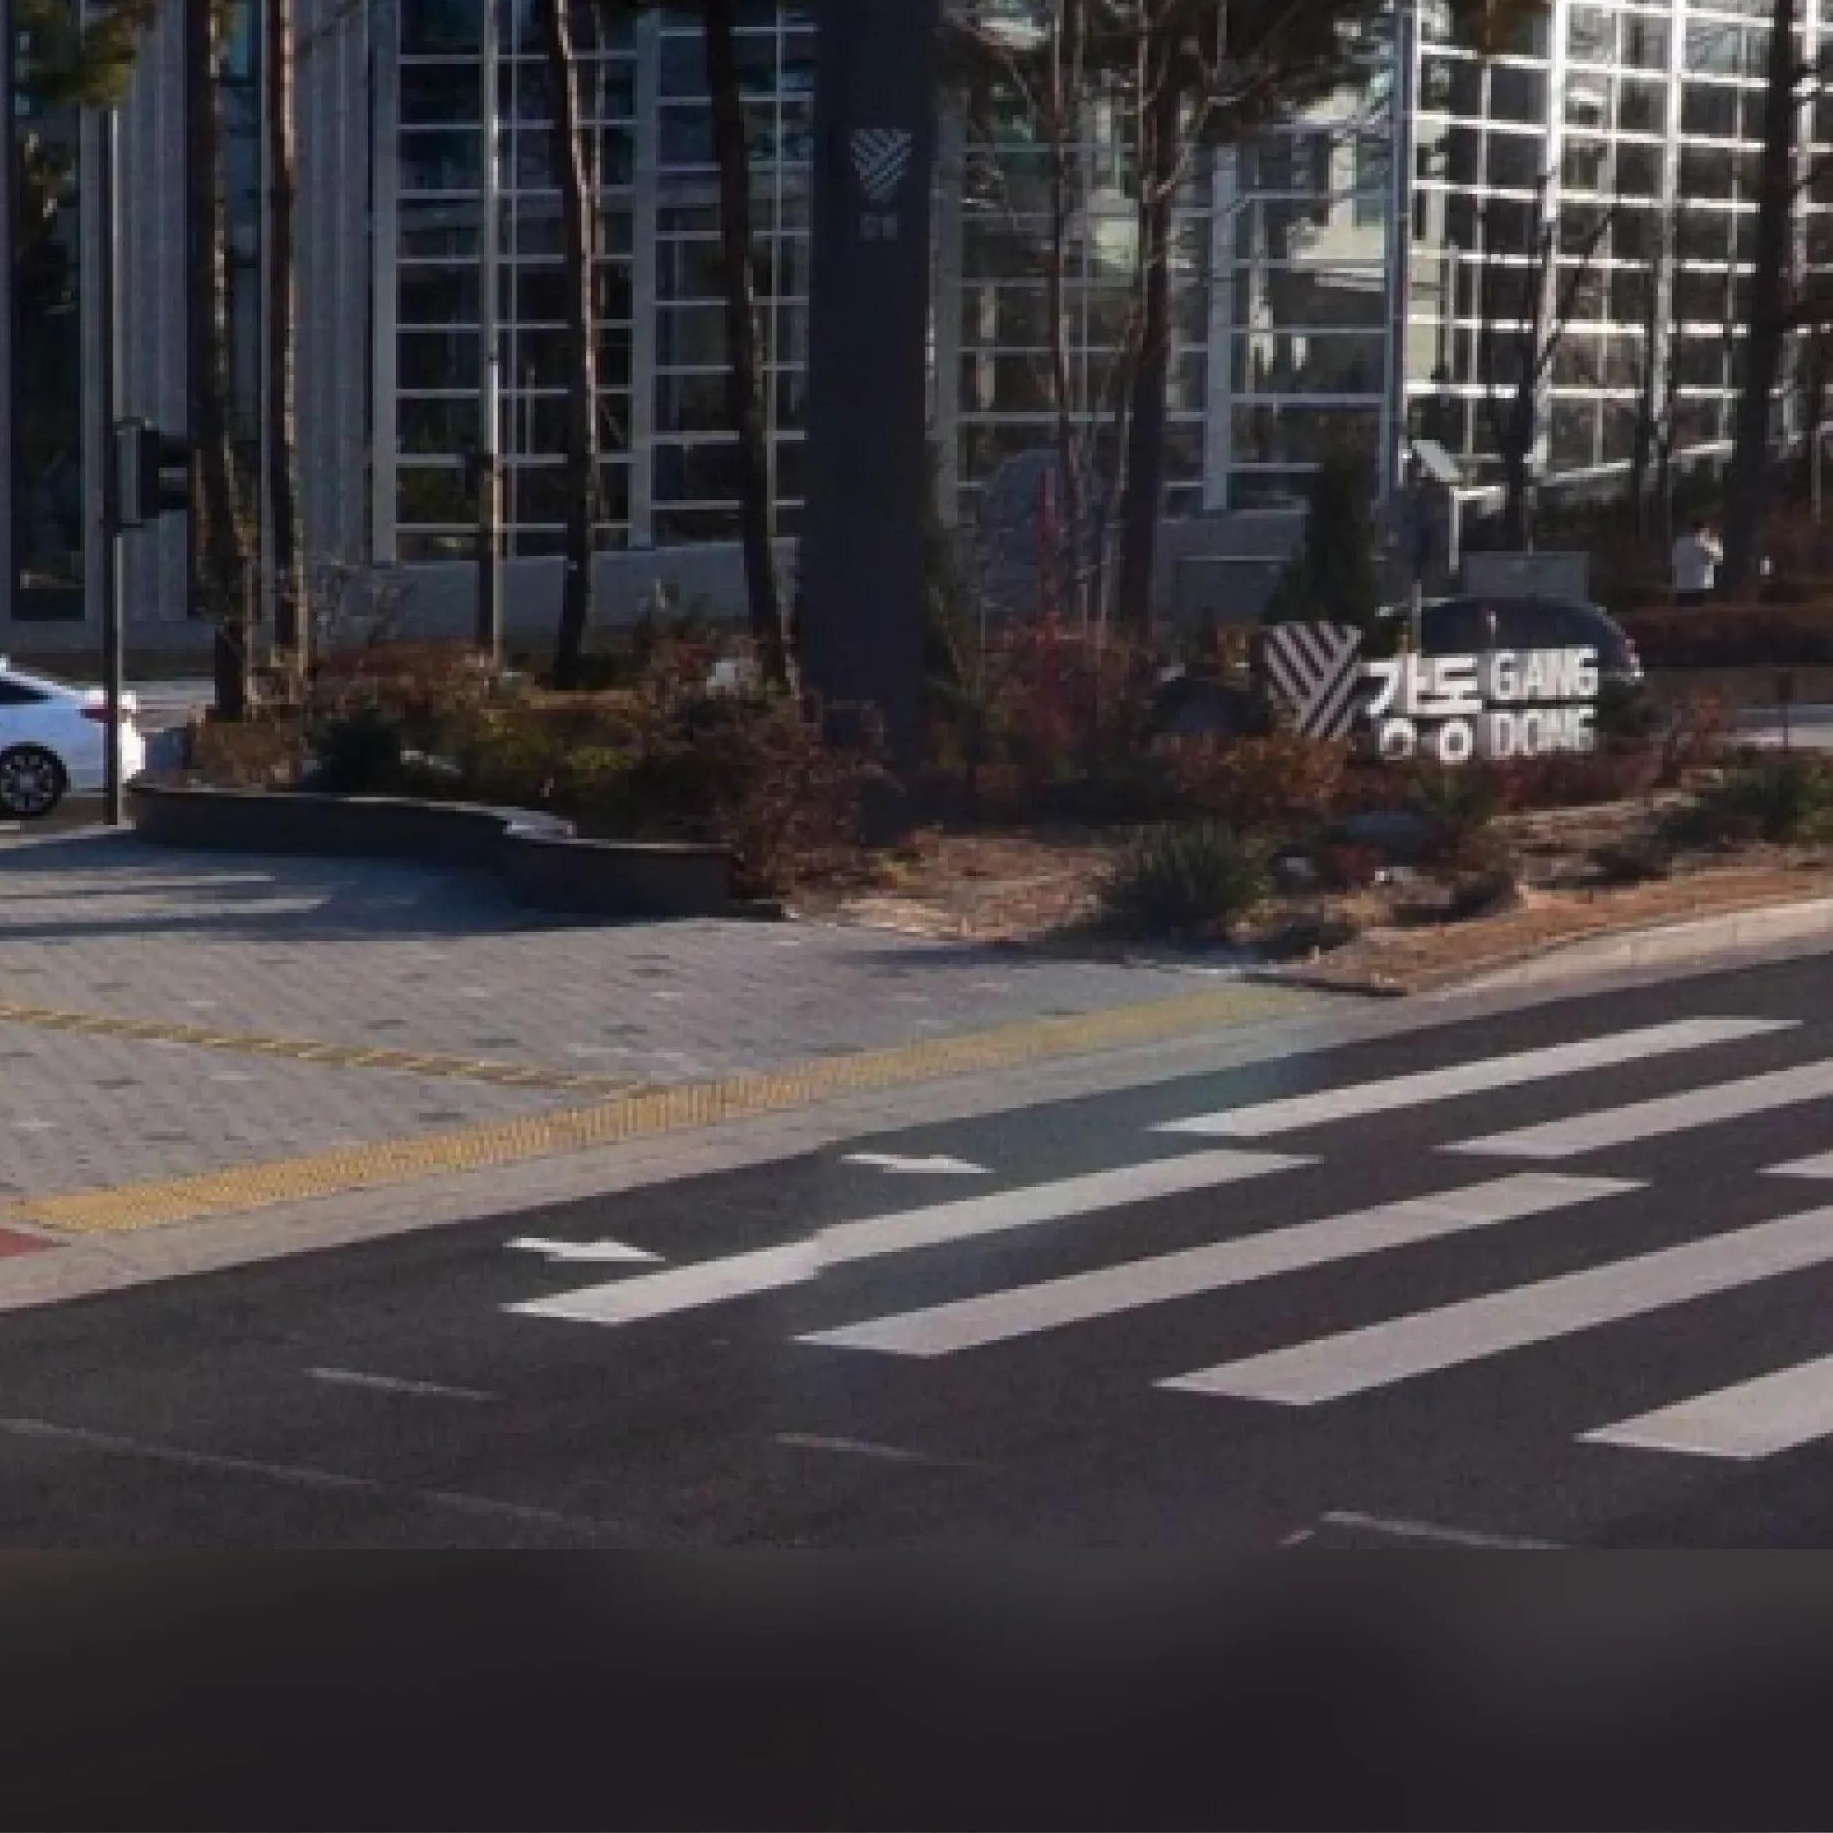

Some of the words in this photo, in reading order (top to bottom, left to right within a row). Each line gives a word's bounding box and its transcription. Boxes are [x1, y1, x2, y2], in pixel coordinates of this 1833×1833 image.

[1490, 647, 1599, 701] GANG
[1367, 652, 1484, 765] 강동
[1490, 707, 1599, 760] DONG
